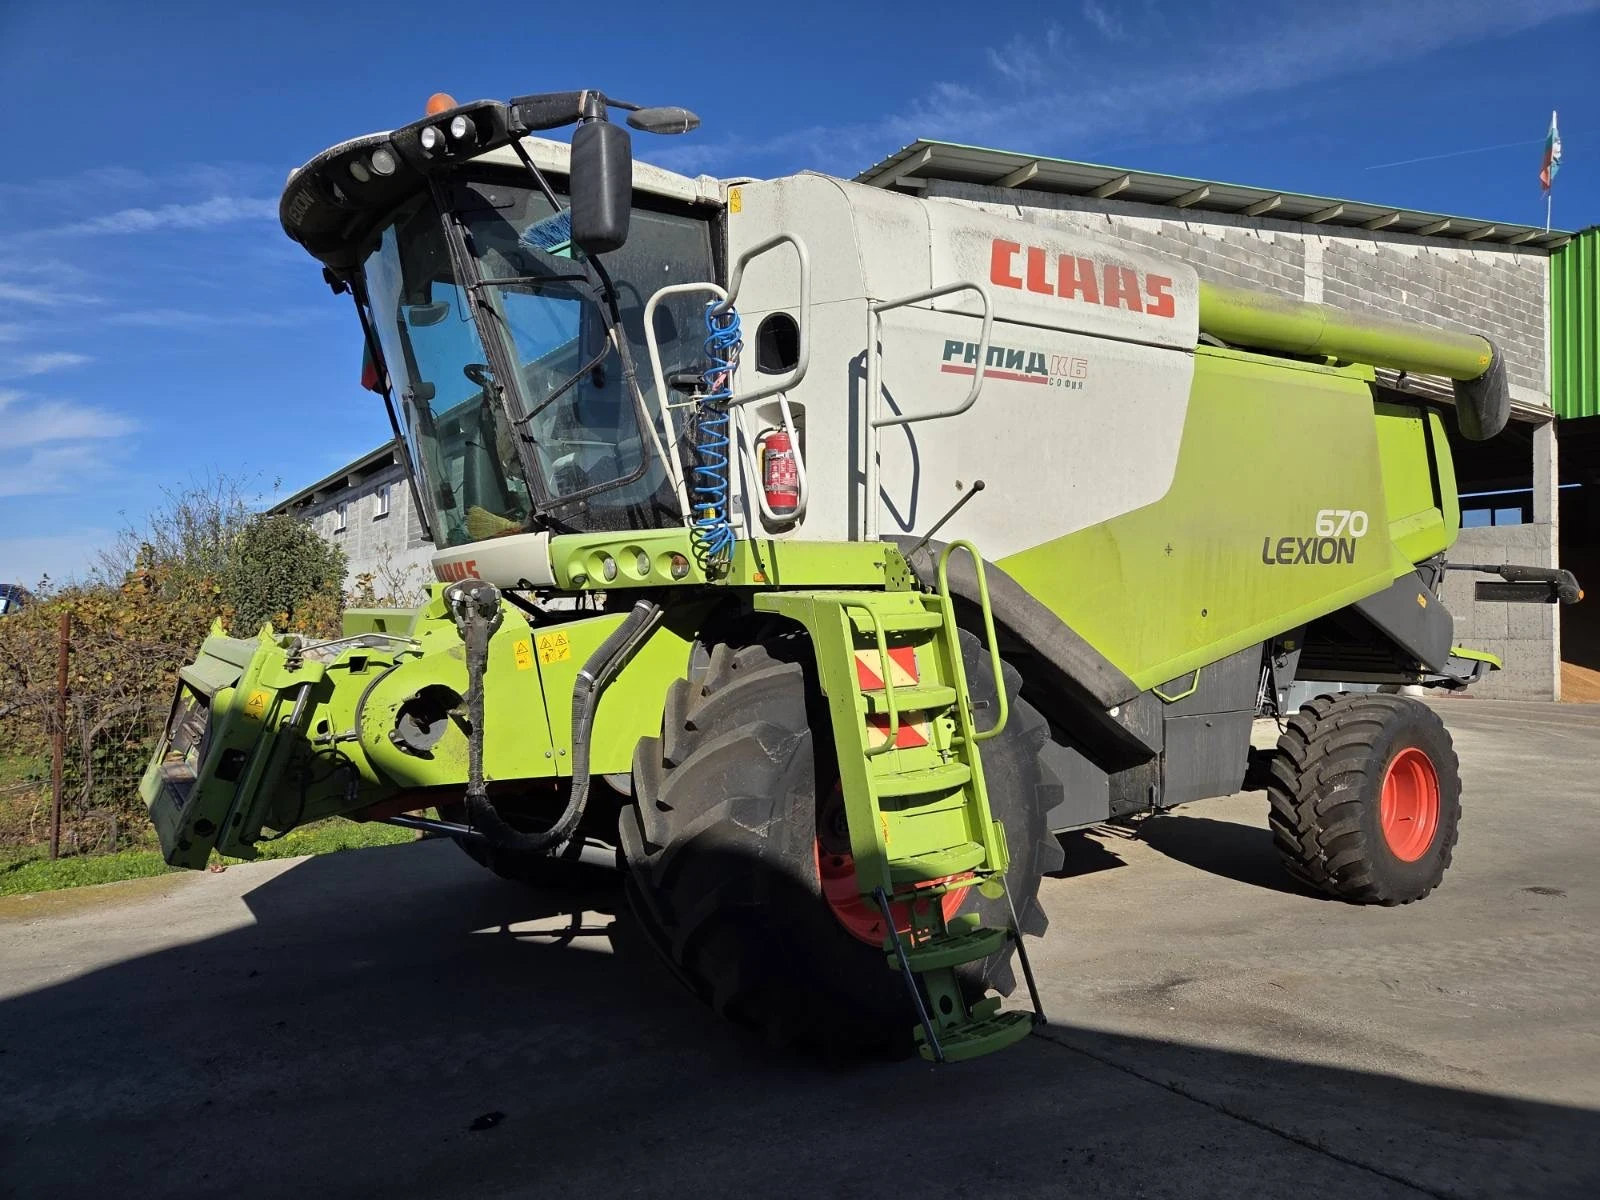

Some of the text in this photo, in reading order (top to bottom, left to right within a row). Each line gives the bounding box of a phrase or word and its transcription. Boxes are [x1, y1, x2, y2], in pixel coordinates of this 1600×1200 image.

[990, 238, 1175, 319] CLAAS
[1049, 377, 1083, 390] СОФИЯ
[1315, 509, 1369, 537] 670
[1262, 536, 1356, 565] LEXION
